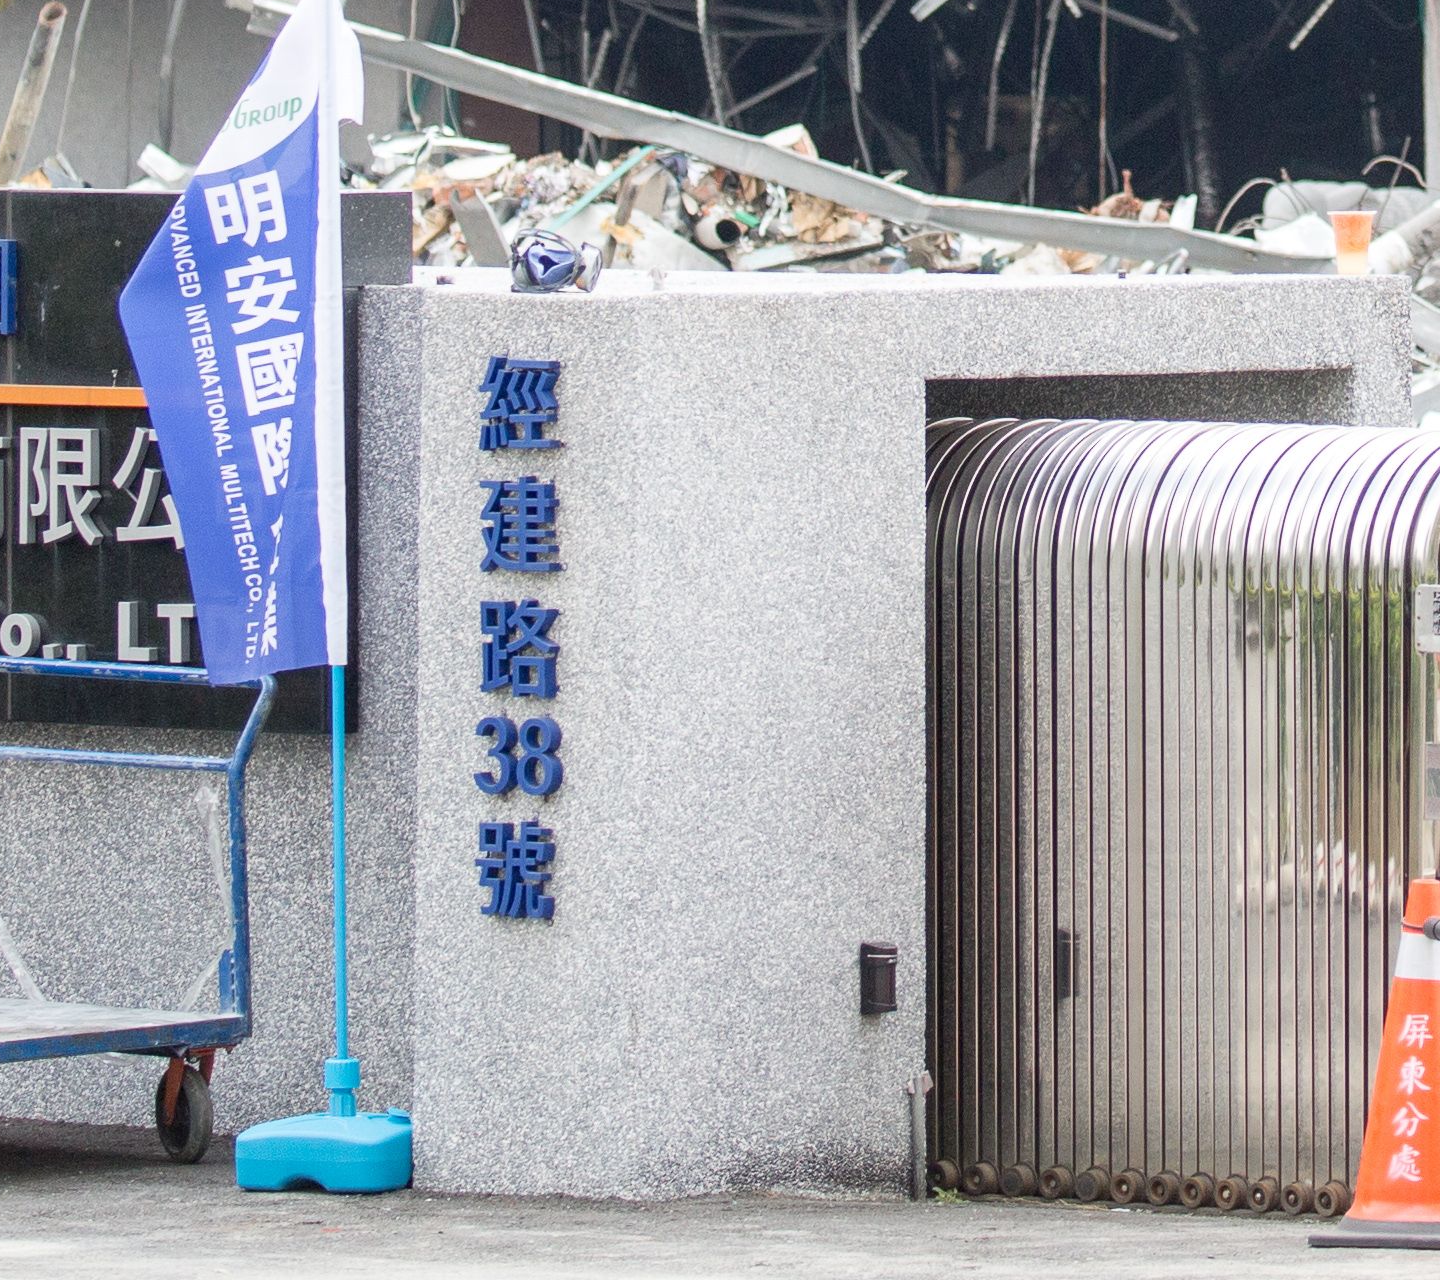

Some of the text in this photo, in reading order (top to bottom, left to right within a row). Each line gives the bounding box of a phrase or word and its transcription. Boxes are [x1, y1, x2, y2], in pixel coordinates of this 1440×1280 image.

[185, 303, 234, 458] INTERNATIONAL
[220, 464, 260, 571] MULTITECH
[475, 355, 563, 919] 經建路38號
[1388, 1014, 1433, 1182] 屏東分處
